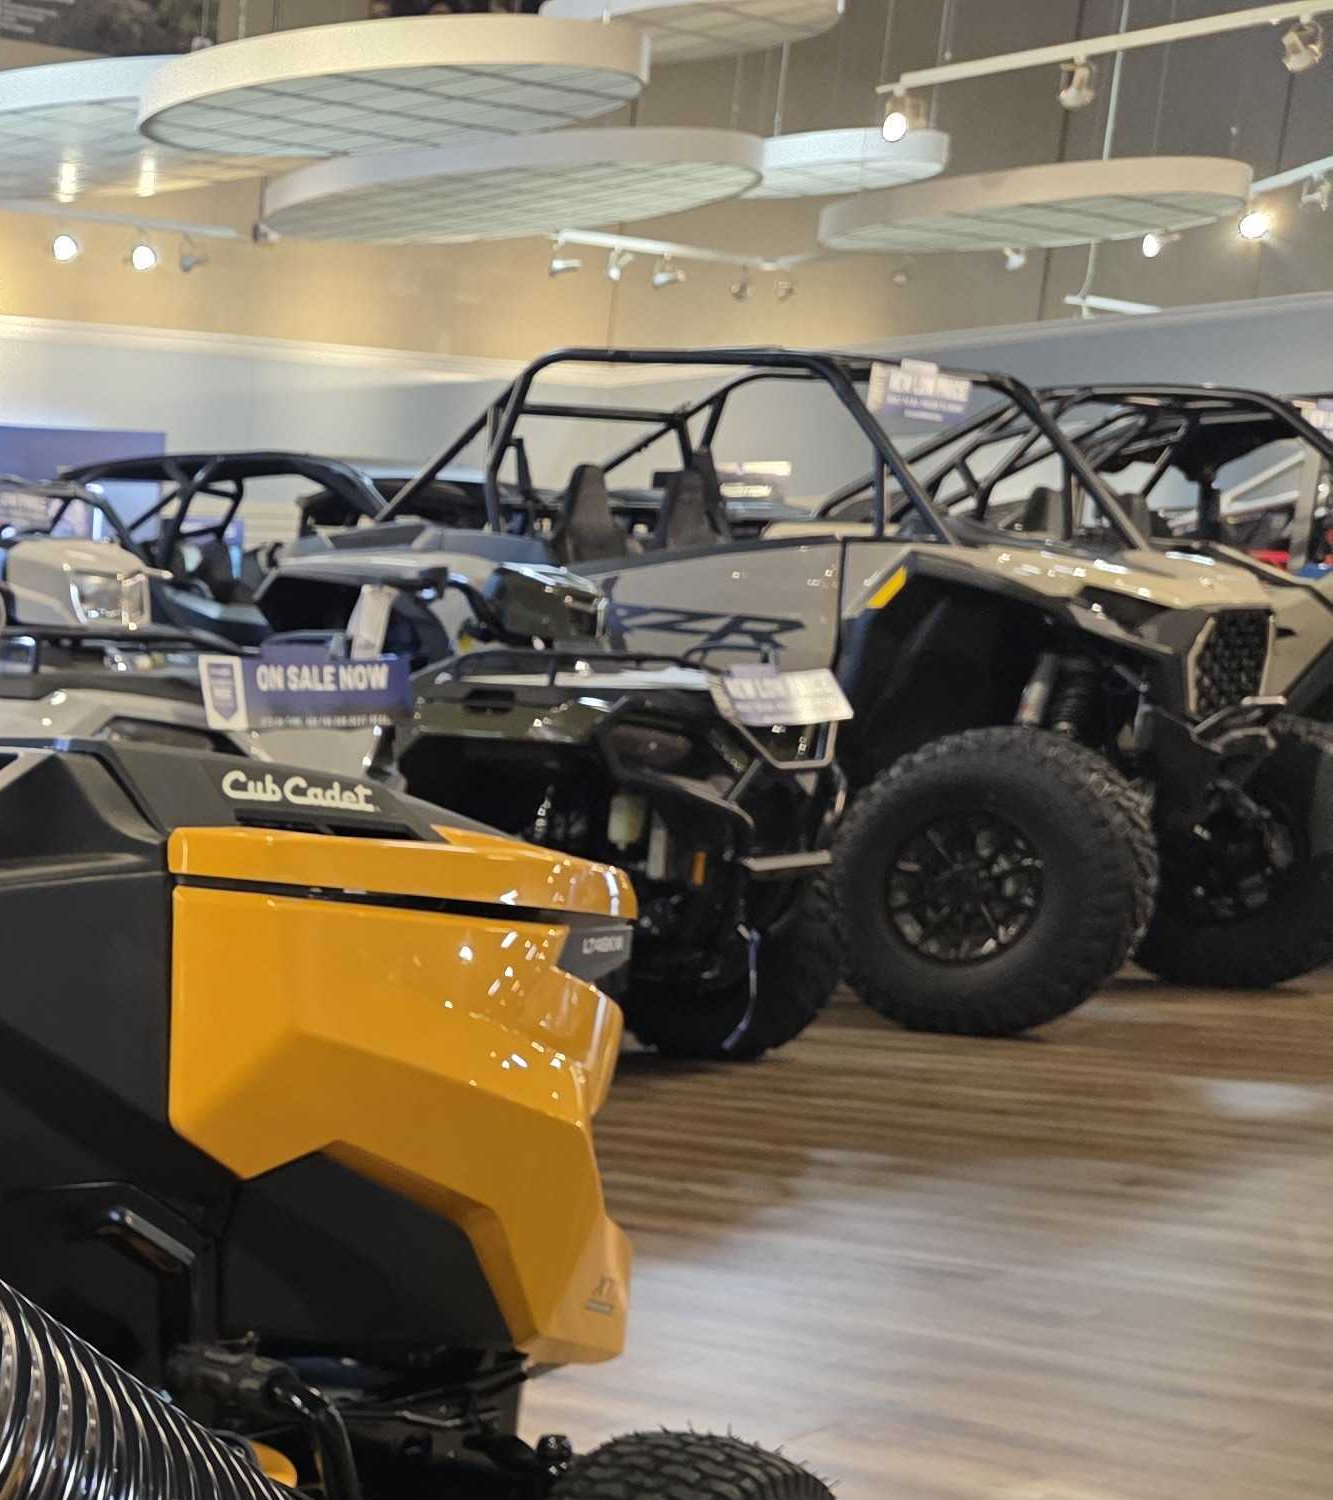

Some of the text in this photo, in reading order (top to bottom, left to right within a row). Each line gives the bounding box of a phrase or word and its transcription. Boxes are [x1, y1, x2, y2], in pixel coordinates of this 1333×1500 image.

[256, 664, 284, 692] ON
[286, 664, 338, 692] SALE
[339, 664, 390, 691] NOW
[221, 769, 376, 812] Cub Cadet
